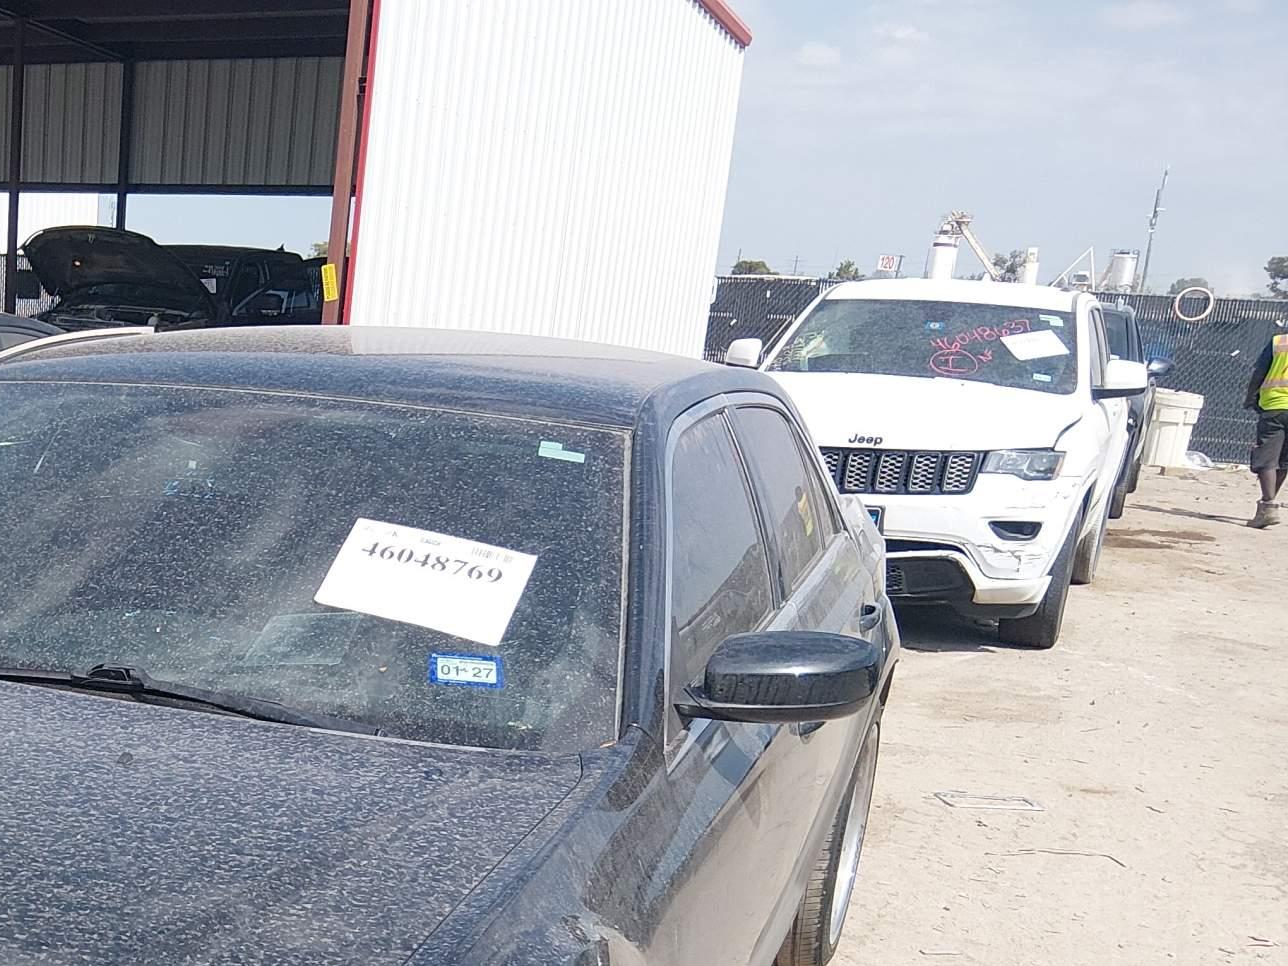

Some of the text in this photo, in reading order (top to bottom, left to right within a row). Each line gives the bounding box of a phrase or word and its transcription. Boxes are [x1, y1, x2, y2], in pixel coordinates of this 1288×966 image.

[881, 255, 895, 270] 120
[848, 433, 884, 447] Jeep
[361, 541, 503, 583] 46048769
[471, 666, 494, 679] 27
